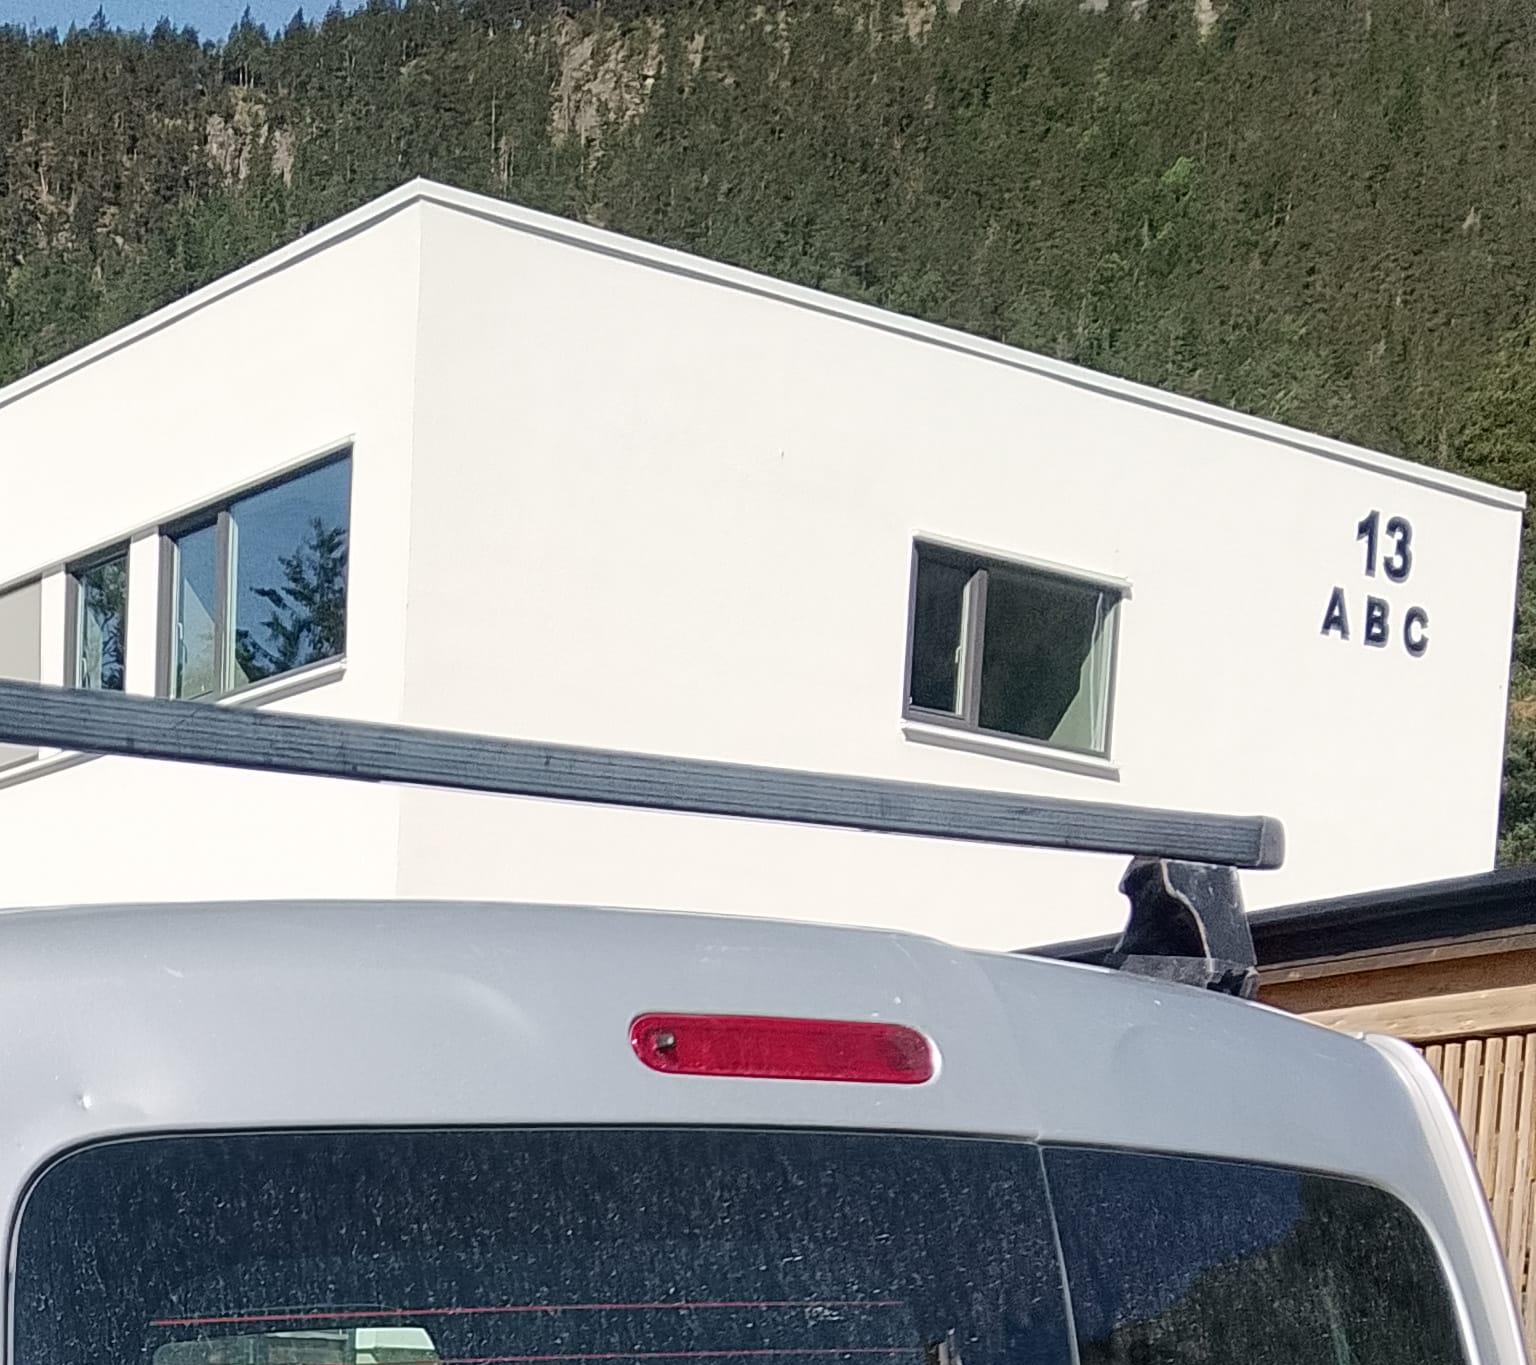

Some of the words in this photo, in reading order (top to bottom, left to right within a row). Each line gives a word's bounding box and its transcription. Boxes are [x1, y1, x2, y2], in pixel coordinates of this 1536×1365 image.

[1356, 509, 1413, 584] 13
[1320, 585, 1350, 641] A
[1363, 594, 1390, 649] B
[1403, 605, 1430, 658] C
